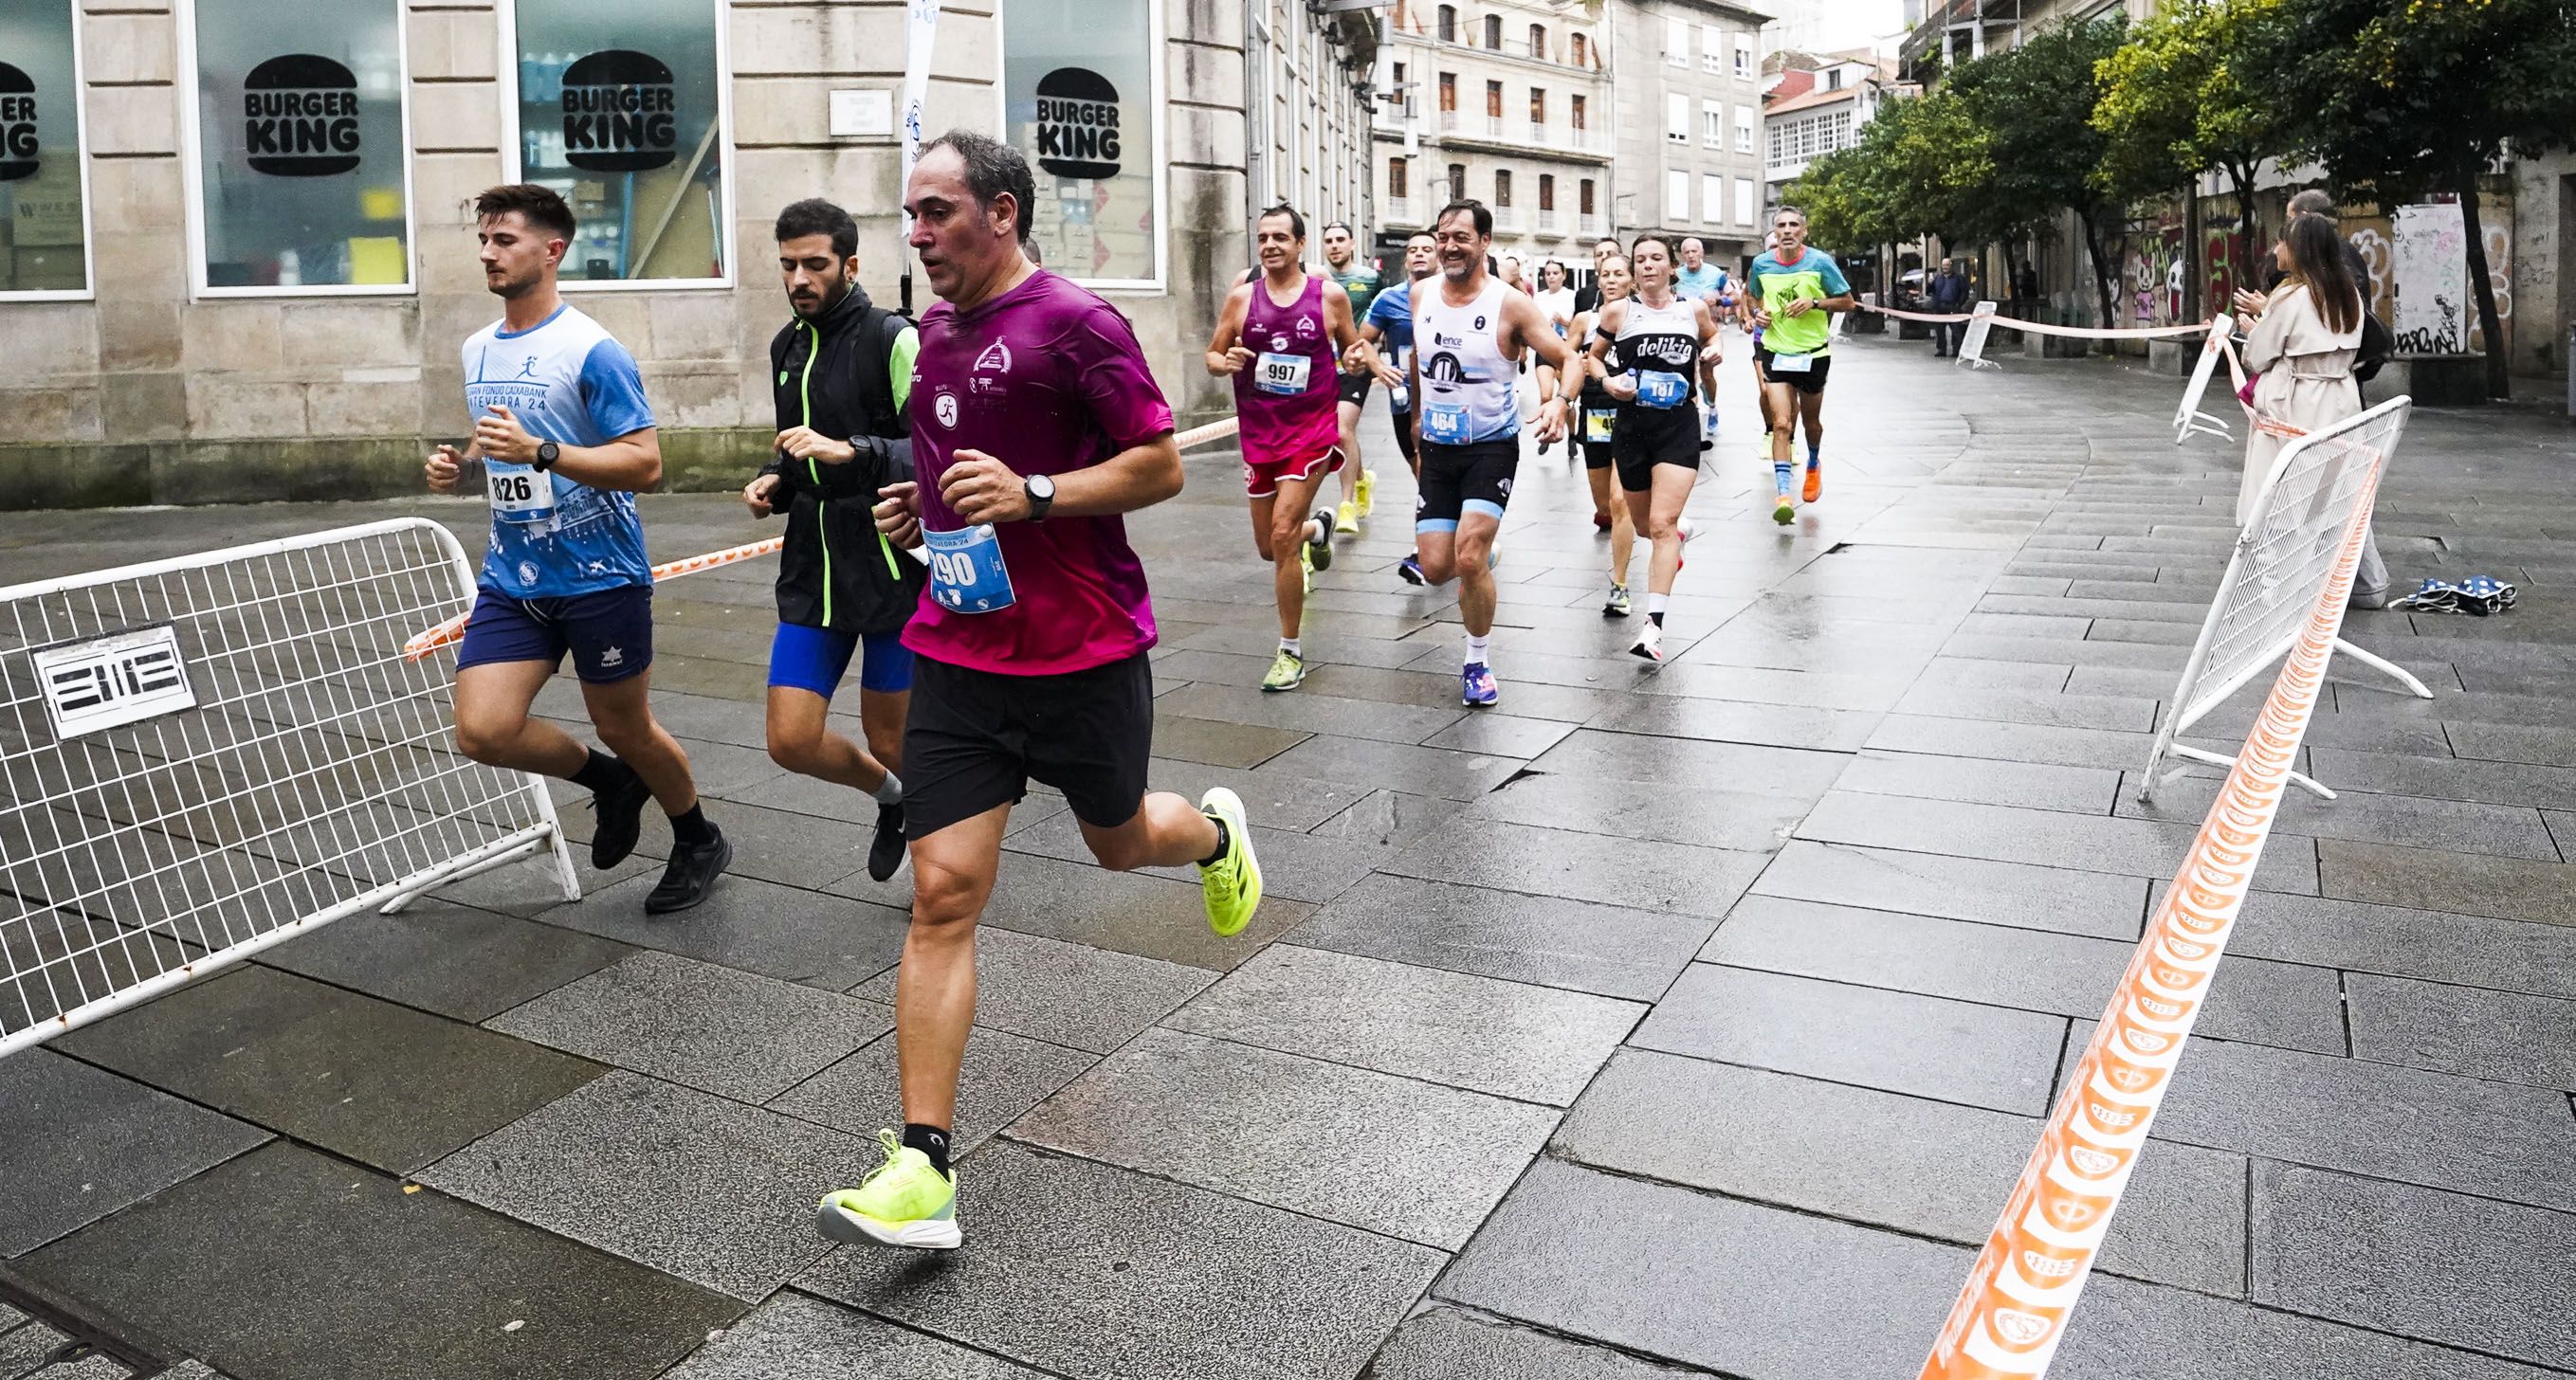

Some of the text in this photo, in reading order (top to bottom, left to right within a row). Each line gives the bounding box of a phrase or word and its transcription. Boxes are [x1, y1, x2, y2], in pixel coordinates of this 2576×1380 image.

[0, 96, 37, 121] ER
[245, 92, 358, 118] BURGER
[562, 87, 675, 113] BURGER
[1037, 99, 1120, 128] BURGER
[246, 118, 360, 154] KING
[563, 113, 676, 150] KING
[1038, 123, 1121, 160] KING
[1442, 336, 1462, 346] ence
[1268, 364, 1295, 381] 997
[482, 385, 504, 395] FONDO
[528, 398, 545, 410] 24
[1432, 411, 1457, 431] 464
[492, 476, 532, 501] 826
[927, 548, 977, 586] 290
